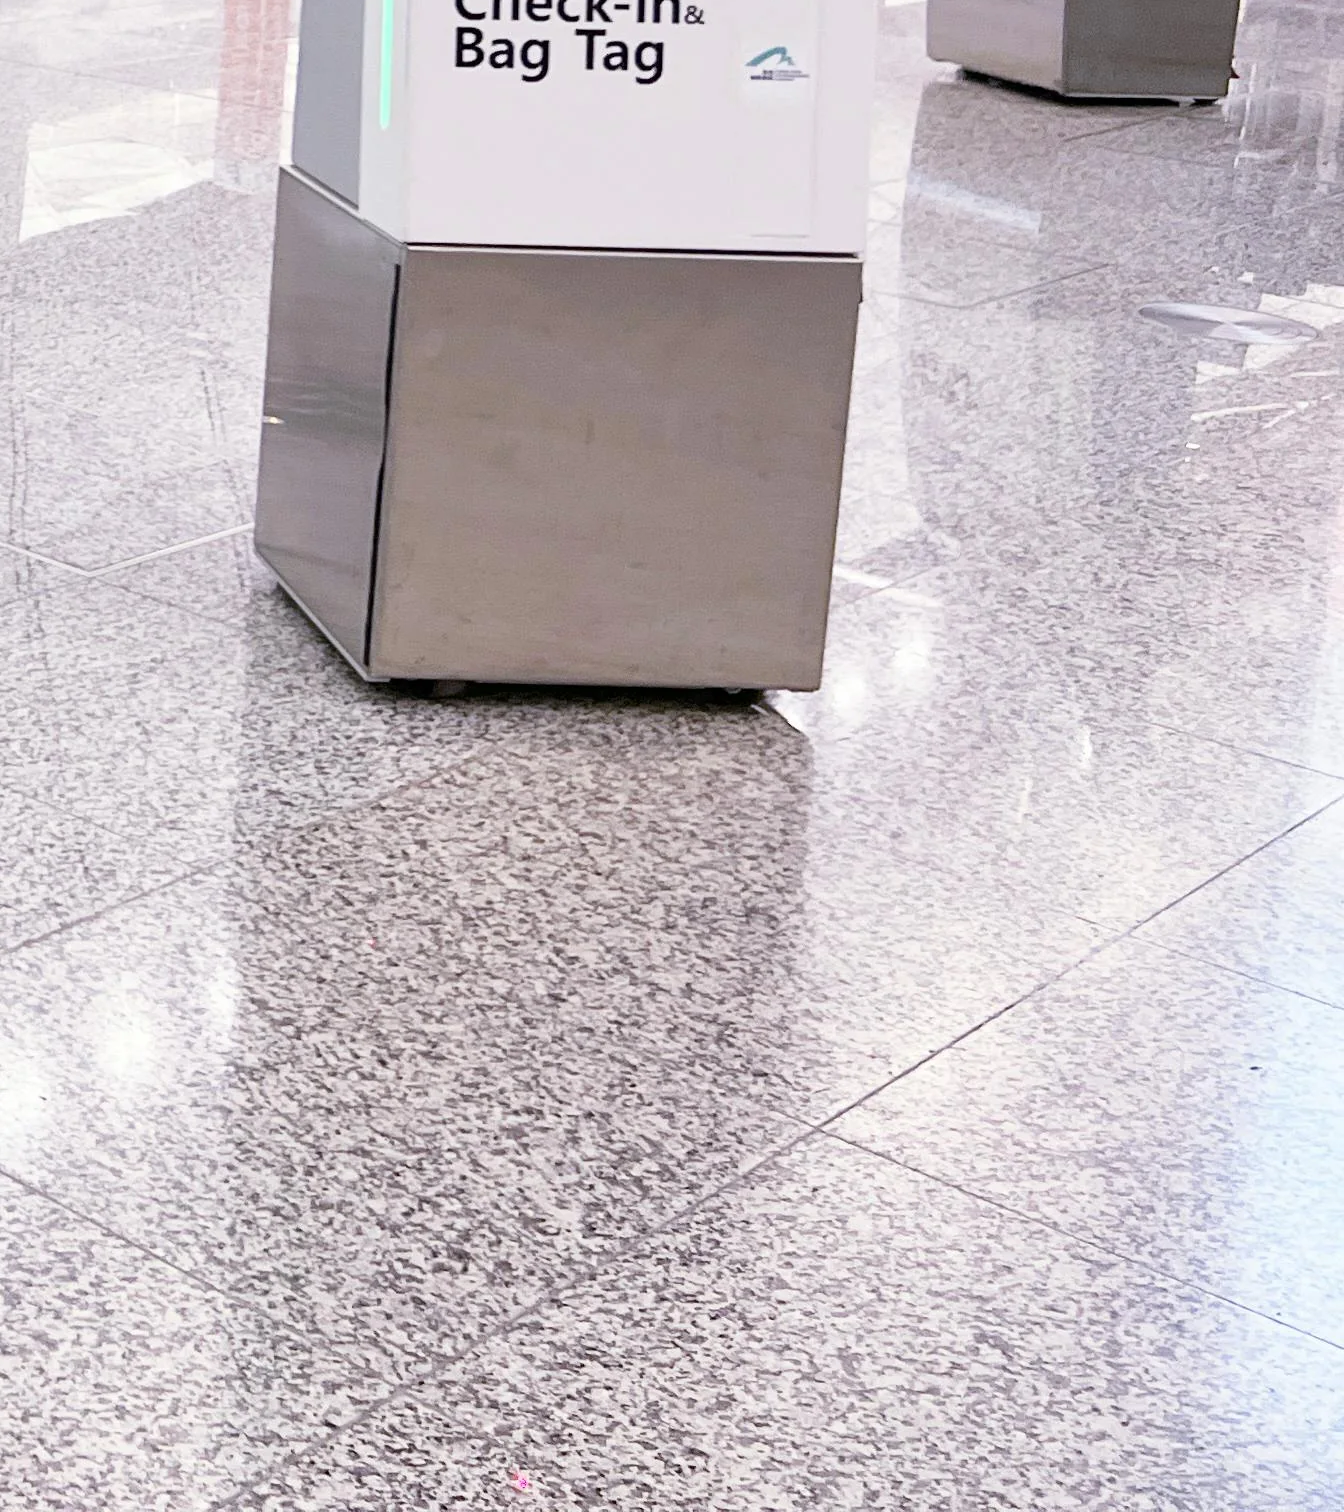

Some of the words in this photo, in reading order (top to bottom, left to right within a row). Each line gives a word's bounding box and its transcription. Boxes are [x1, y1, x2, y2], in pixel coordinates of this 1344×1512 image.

[683, 4, 706, 26] &
[454, 26, 551, 83] Bag
[575, 28, 665, 85] Tag
